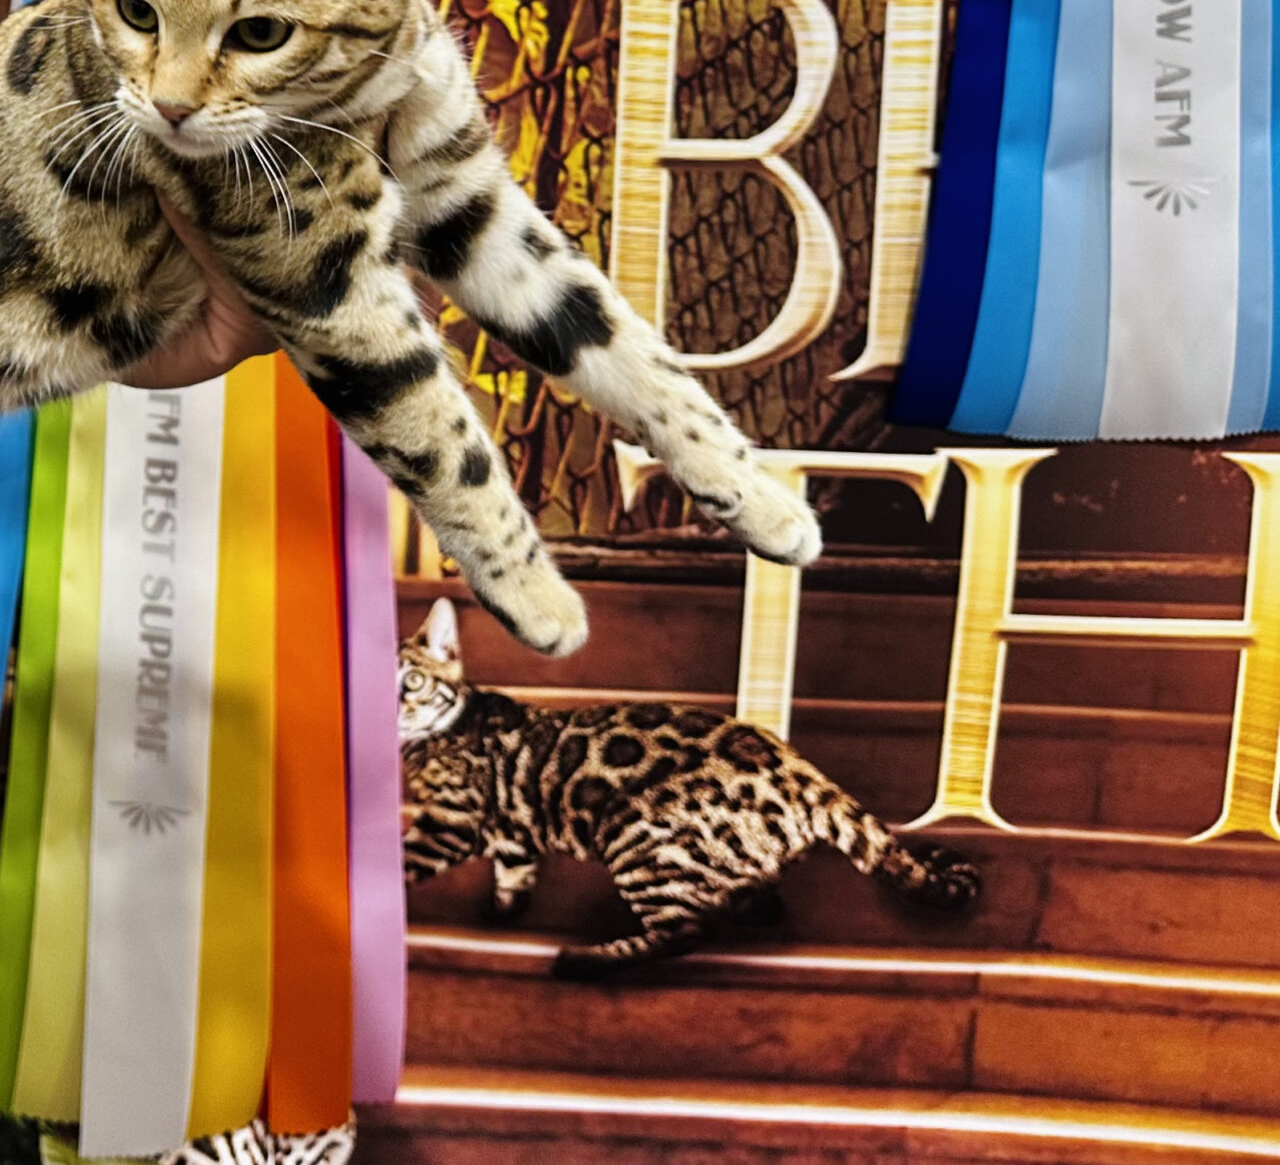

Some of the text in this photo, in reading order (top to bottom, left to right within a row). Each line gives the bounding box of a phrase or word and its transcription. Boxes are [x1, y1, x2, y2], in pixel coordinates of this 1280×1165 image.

[1152, 61, 1192, 147] AFM
[134, 392, 182, 764] FM BEST SUPREME
